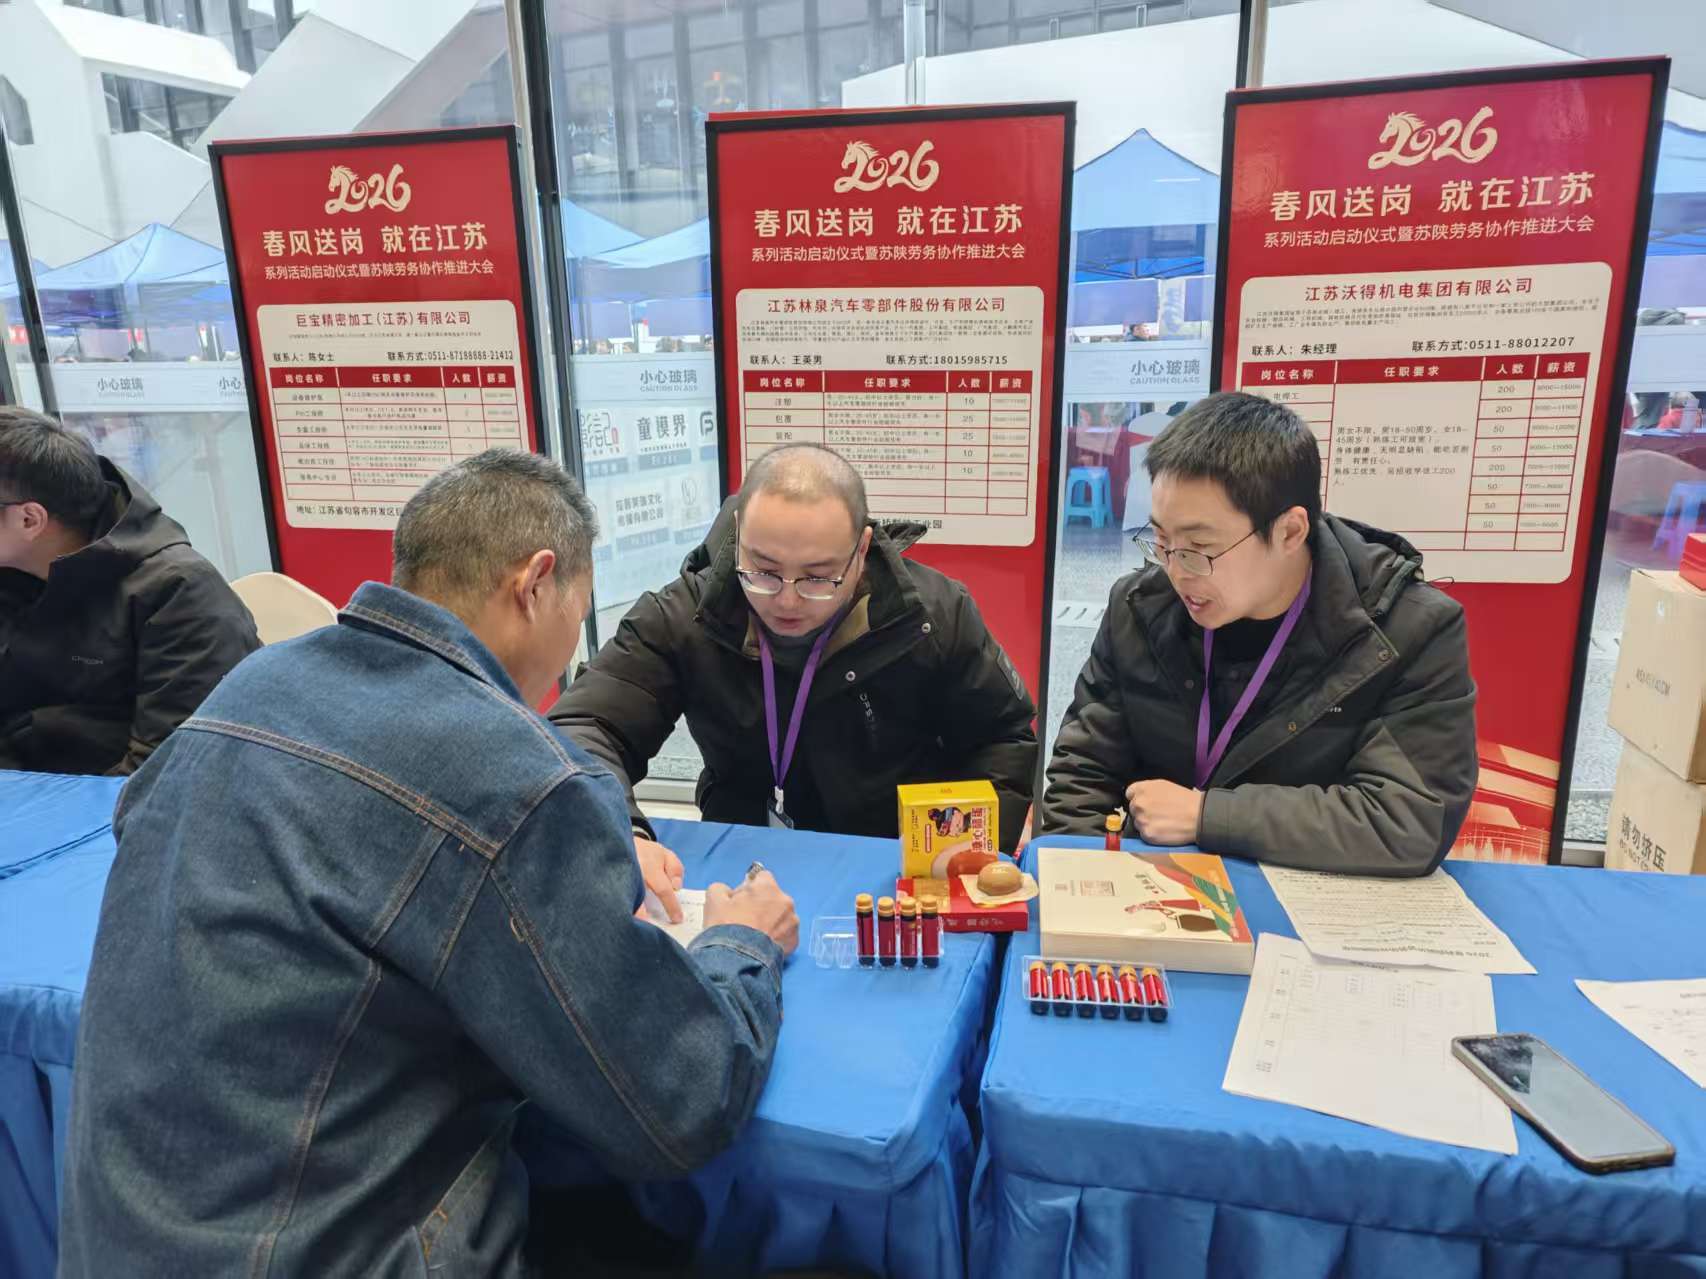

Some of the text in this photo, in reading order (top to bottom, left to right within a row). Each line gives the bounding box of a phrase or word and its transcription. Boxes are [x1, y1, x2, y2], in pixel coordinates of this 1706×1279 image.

[1368, 106, 1498, 171] 2026
[833, 140, 940, 193] 2026
[325, 164, 411, 214] 2026
[1270, 171, 1596, 222] 春风送岗 就在江苏
[754, 203, 1023, 237] 春风送岗 就在江苏
[263, 222, 488, 257] 春风送岗 就在江苏
[1263, 215, 1595, 249] 系列活动启动仪式暨苏陕劳务协作推进大会
[751, 243, 1025, 262] 系列活动启动仪式暨苏陕劳务协作推进大会
[265, 260, 494, 280] 系列活动启动仪式暨苏陕劳务协作推进大会
[1304, 277, 1533, 302] 江苏沃得机电集团有限公司
[767, 297, 1006, 314] 江苏林泉汽车零部件股份有限公司
[640, 369, 697, 384] 小心玻璃
[1131, 359, 1200, 375] 小心玻璃
[1260, 361, 1576, 380] 岗位名称 任职要求 人数 薪资
[98, 377, 143, 391] 小心玻璃
[759, 378, 806, 389] 岗位名称
[864, 378, 911, 389] 任职要求
[957, 378, 981, 389] 人数
[1497, 385, 1516, 393] 200
[1495, 405, 1512, 413] 200
[637, 414, 687, 441] 童模界
[1493, 425, 1505, 433] 50
[963, 449, 974, 458] 10
[1491, 444, 1503, 452] 50
[1488, 463, 1506, 471] 200
